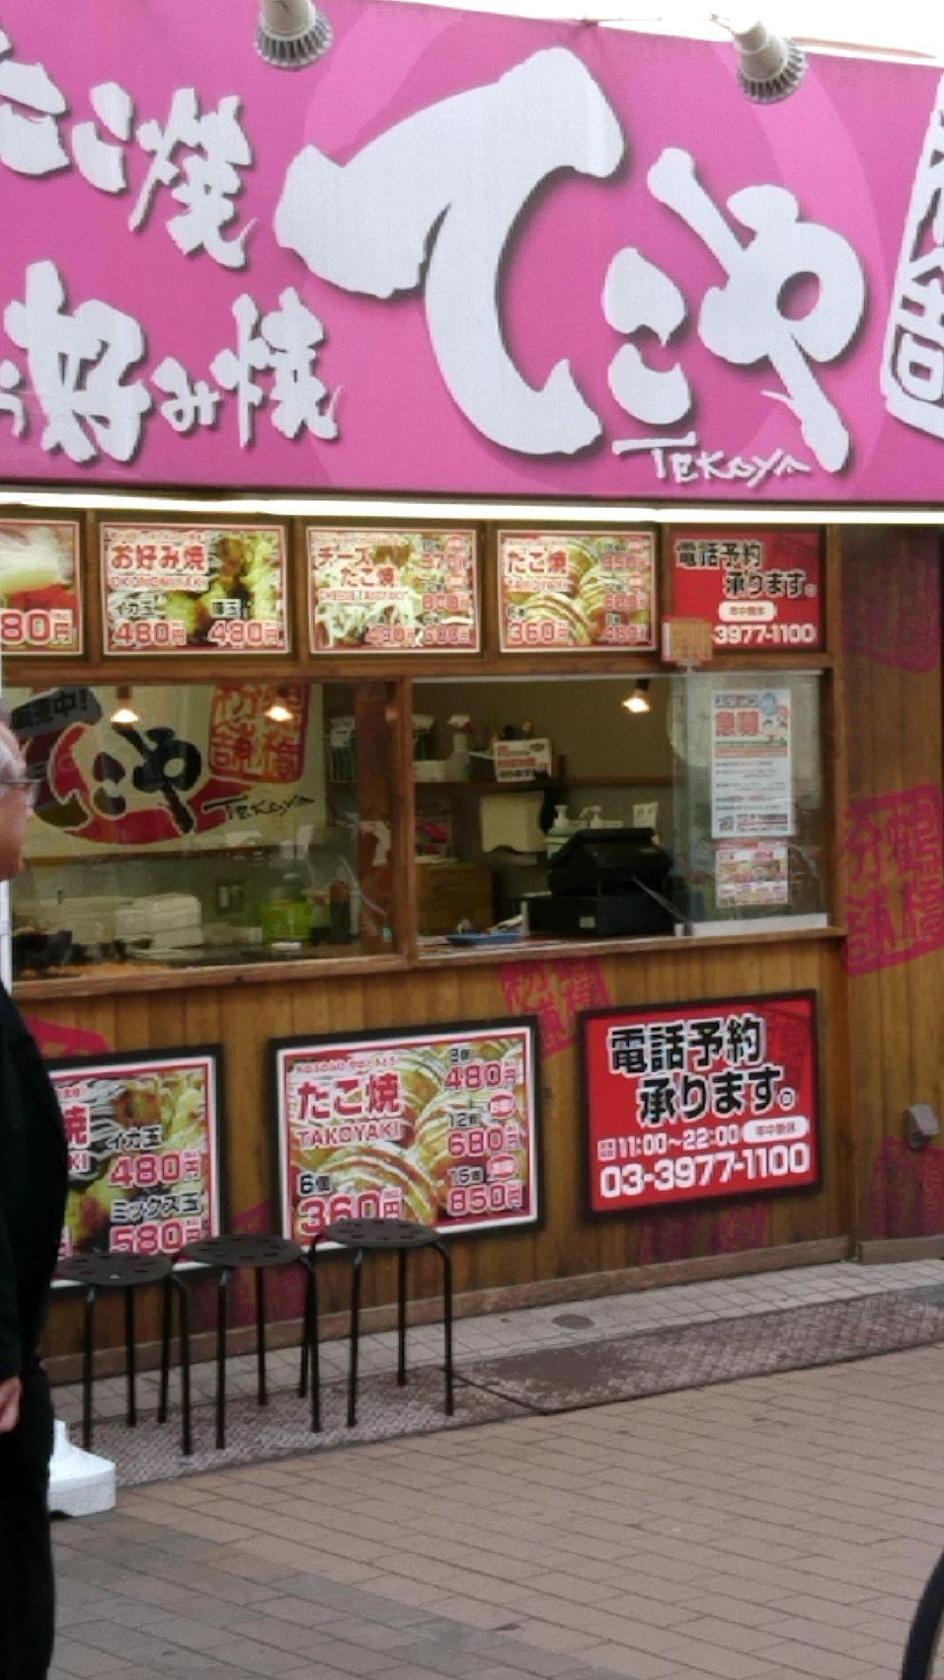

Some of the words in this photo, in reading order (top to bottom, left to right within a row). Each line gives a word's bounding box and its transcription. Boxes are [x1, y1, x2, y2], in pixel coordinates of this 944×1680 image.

[275, 46, 866, 472] てこや
[111, 544, 207, 571] お好み焼
[506, 550, 567, 573] たこ焼
[677, 541, 761, 568] 電話予約
[725, 570, 816, 597] 承ります。
[611, 1016, 762, 1074] 電話予約
[446, 1063, 516, 1090] 480円
[298, 1072, 400, 1120] たこ焼
[640, 1066, 795, 1124] 承ります。
[107, 1127, 162, 1151] イカ玉
[297, 1122, 401, 1147] TAKOYAKI
[448, 1126, 520, 1157] 680円
[110, 1151, 201, 1186] 480円
[600, 1142, 810, 1198] 03-3977-1100
[111, 1194, 201, 1221] ミックス玉
[448, 1182, 521, 1215] 850円
